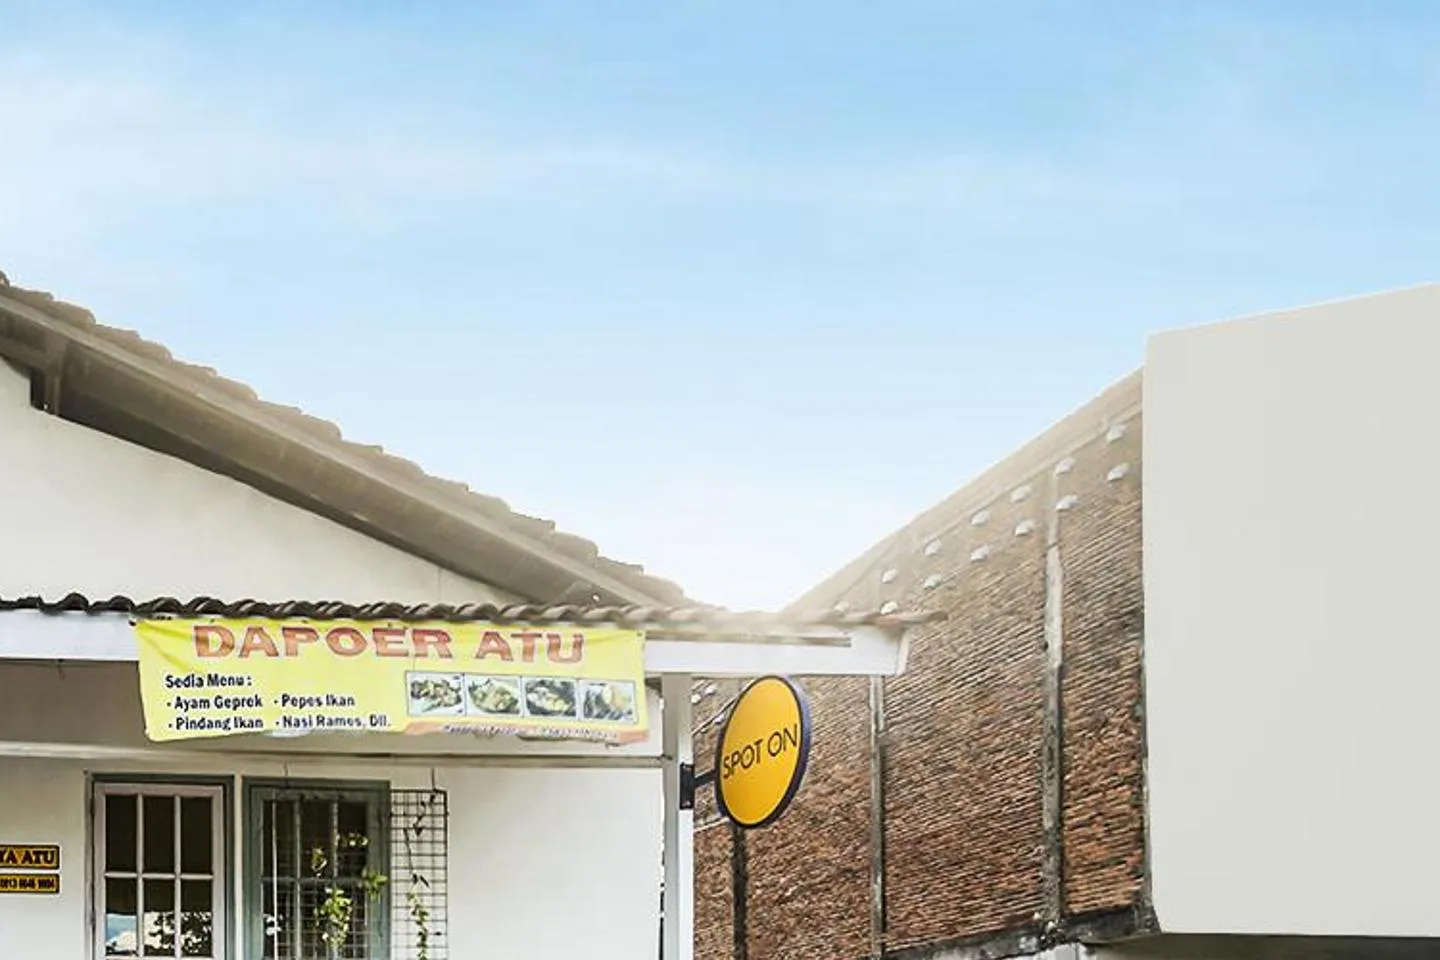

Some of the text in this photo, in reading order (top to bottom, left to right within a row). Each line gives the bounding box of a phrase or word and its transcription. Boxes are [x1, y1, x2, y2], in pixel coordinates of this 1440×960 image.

[193, 624, 584, 664] DAPOER ATU
[165, 673, 204, 689] Sedia
[174, 694, 263, 713] Ayam Geprek
[281, 693, 355, 709] Pepes Ikan
[175, 715, 264, 731] Pindang Ikan
[282, 714, 313, 728] Nasi
[723, 723, 798, 779] SPOT ON
[21, 849, 55, 864] ATU
